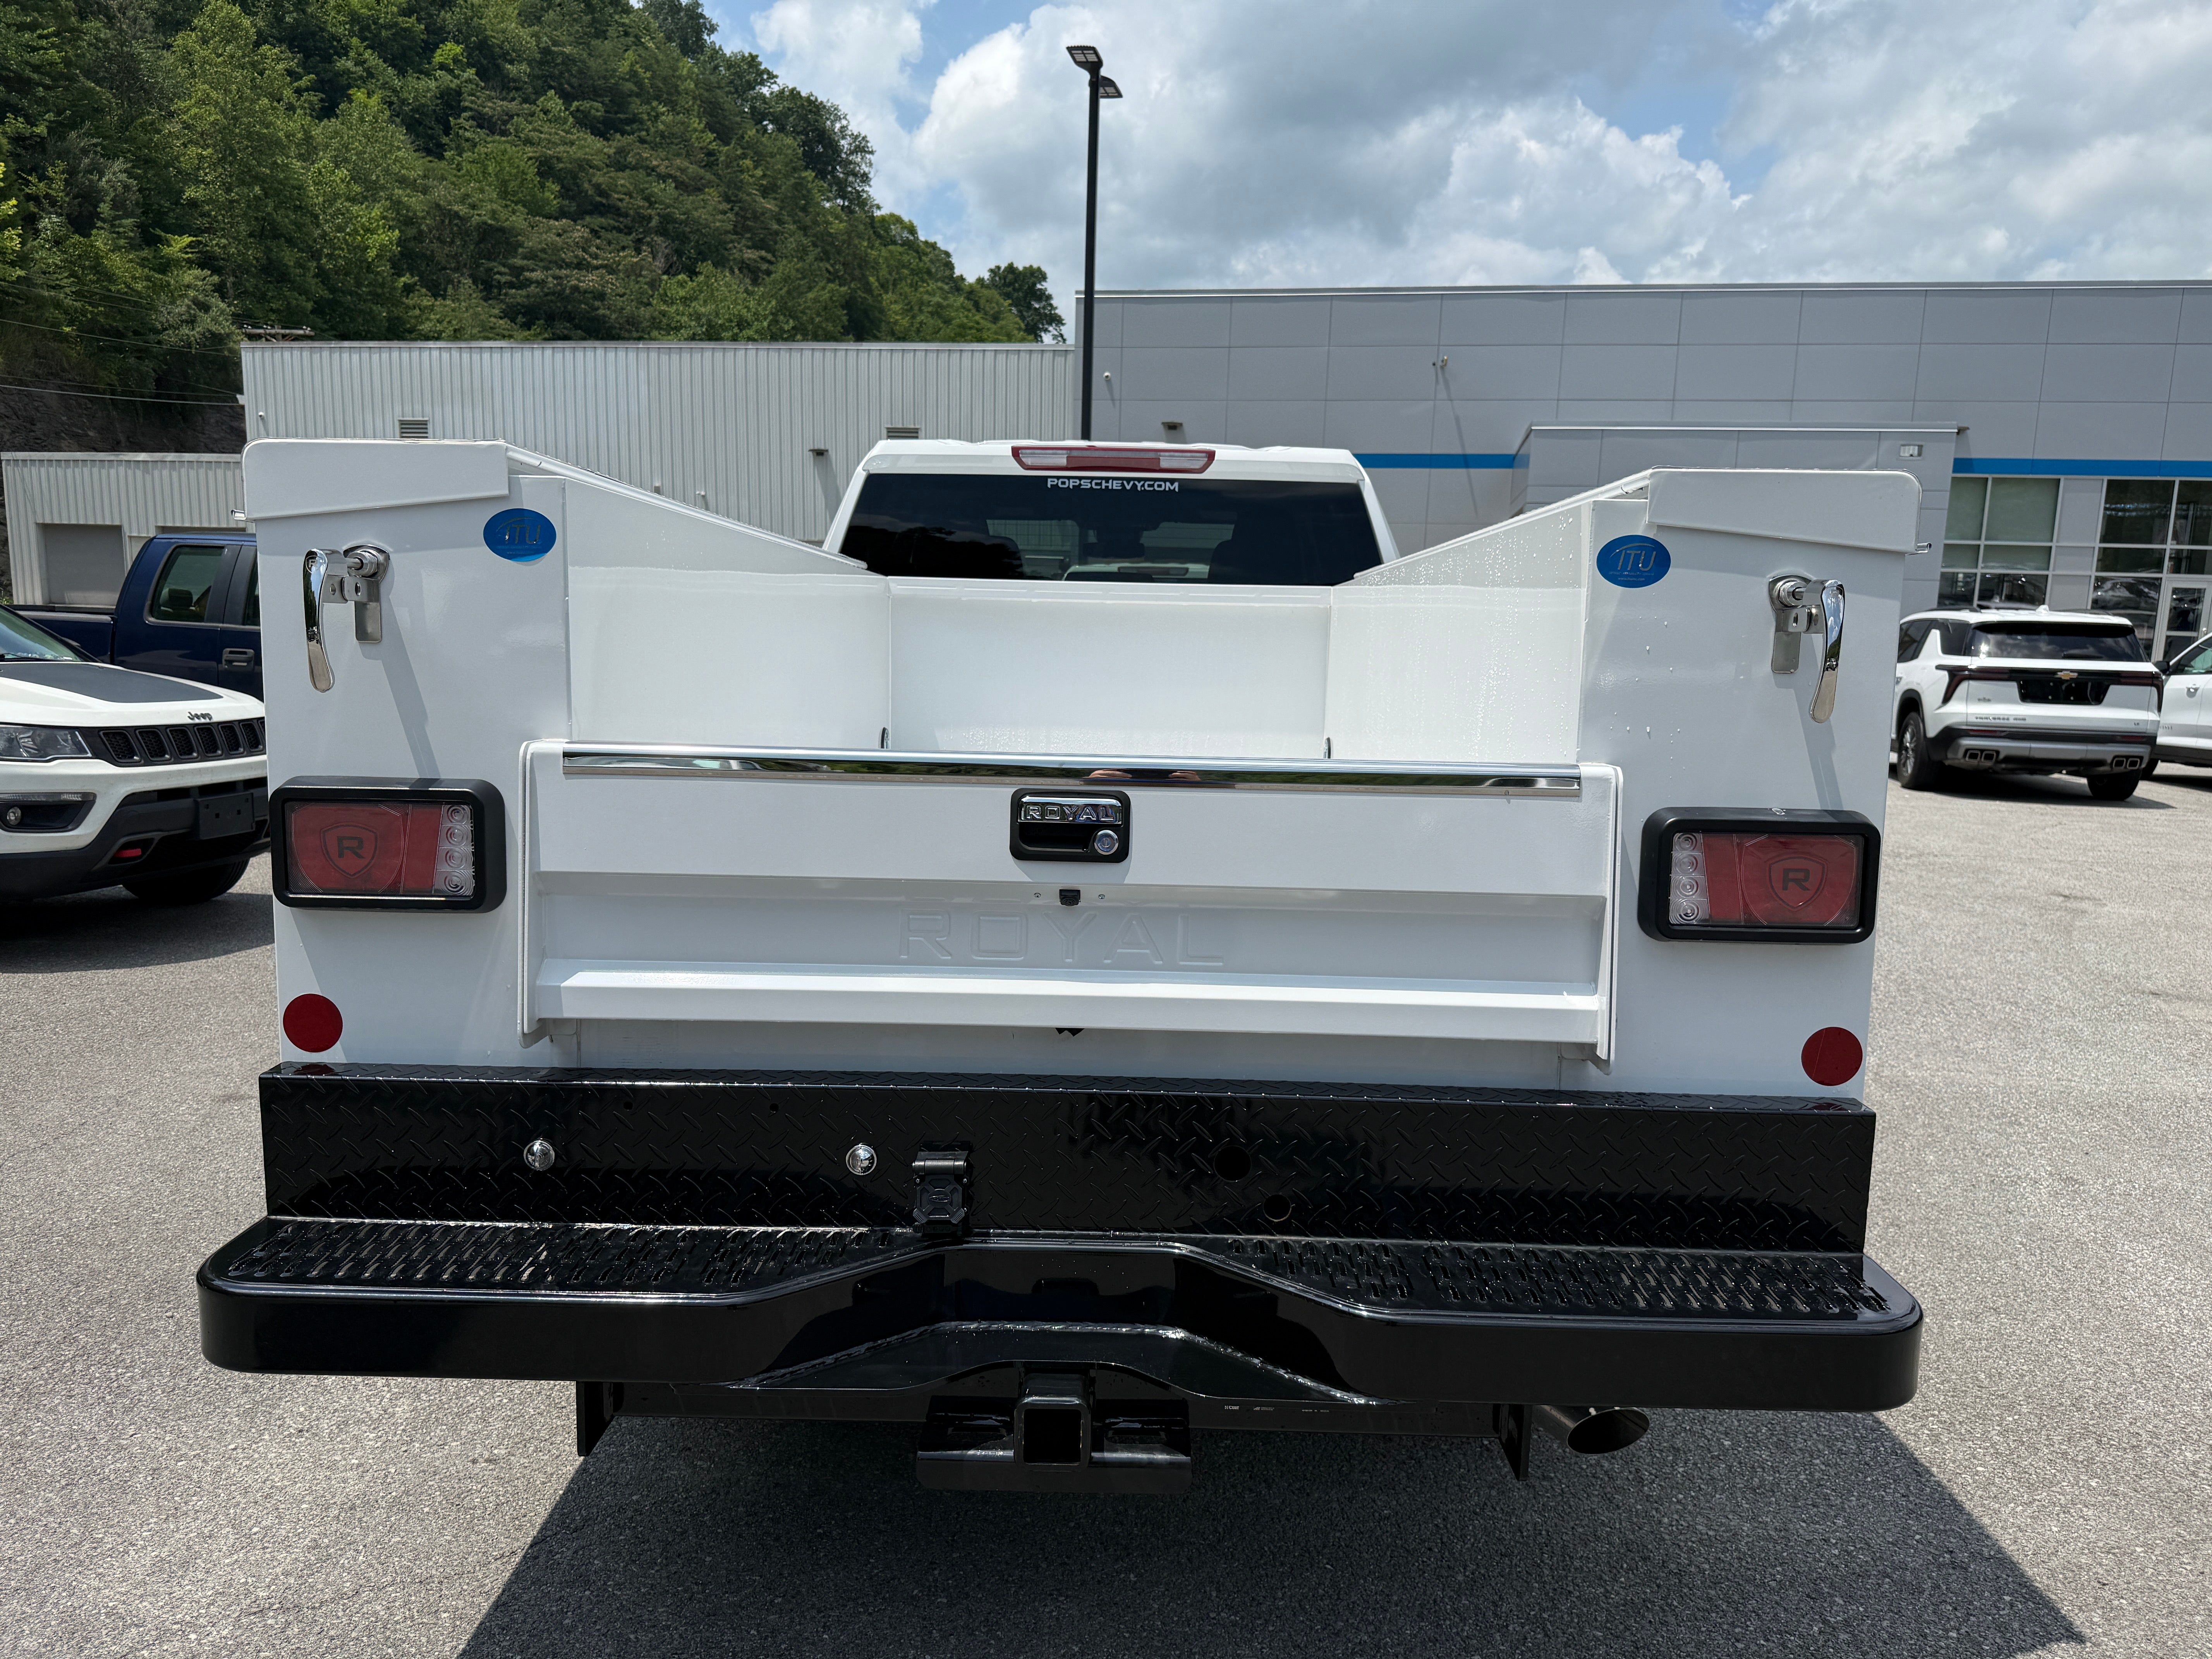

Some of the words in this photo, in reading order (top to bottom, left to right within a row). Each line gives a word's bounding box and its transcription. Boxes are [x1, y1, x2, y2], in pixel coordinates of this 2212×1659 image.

[1048, 478, 1178, 492] POPSCHEVY.COM
[505, 525, 541, 544] ITU
[1618, 550, 1656, 571] ITU
[187, 712, 213, 721] Jeep
[1026, 805, 1115, 821] ROYAL
[337, 836, 365, 859] R
[1782, 868, 1810, 891] R
[899, 908, 1224, 966] ROYAL
